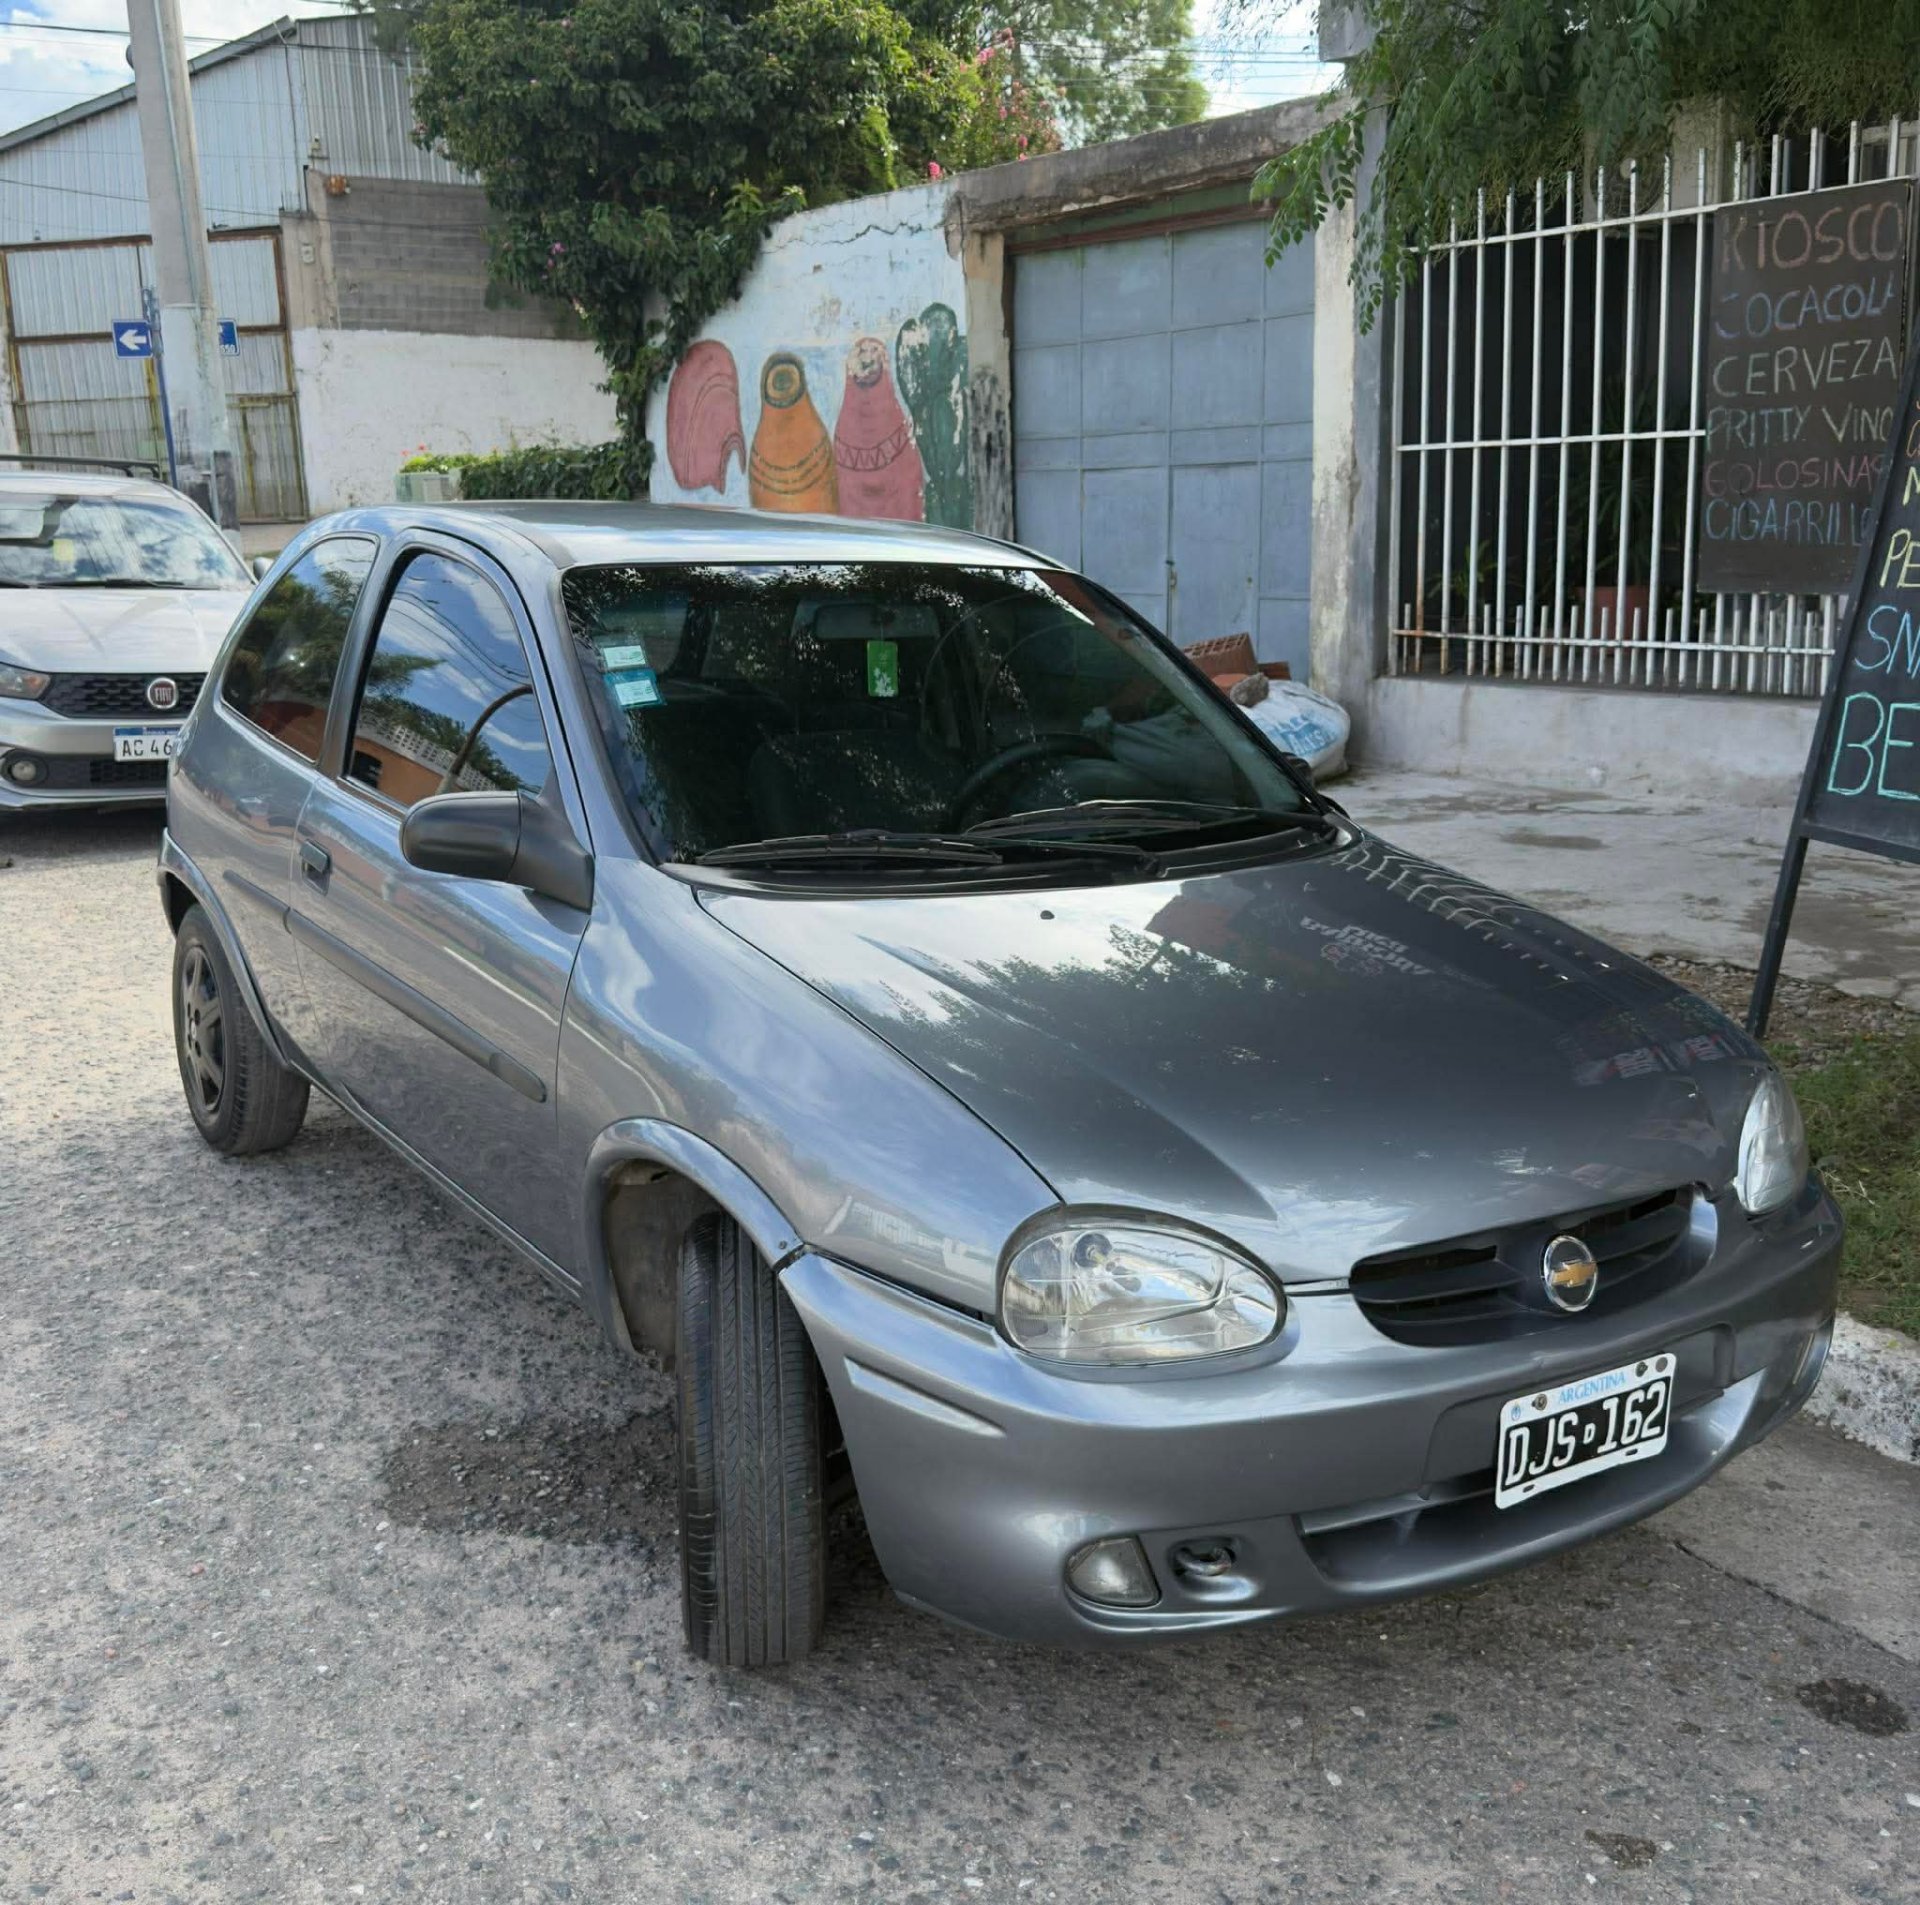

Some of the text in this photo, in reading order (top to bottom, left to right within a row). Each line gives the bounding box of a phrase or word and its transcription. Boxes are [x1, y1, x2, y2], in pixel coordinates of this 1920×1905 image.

[1712, 335, 1898, 397] CERVEZA
[1704, 405, 1812, 454] PRITTY
[122, 739, 144, 757] AC
[1559, 1372, 1626, 1405] ARGENTINA
